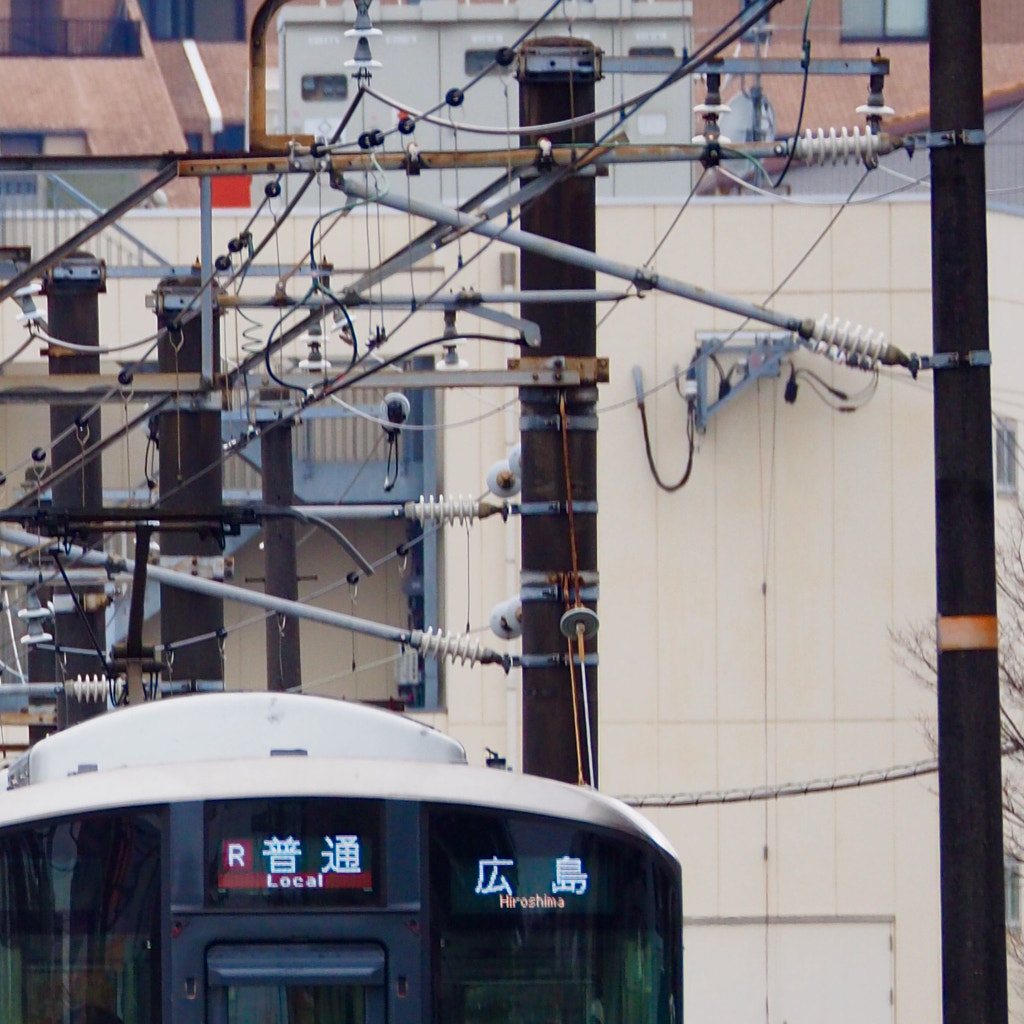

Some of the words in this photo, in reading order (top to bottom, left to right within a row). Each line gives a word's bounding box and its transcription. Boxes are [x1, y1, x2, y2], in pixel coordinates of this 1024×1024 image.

[228, 843, 245, 867] R
[262, 835, 361, 873] 普通
[267, 873, 323, 888] Local
[475, 855, 588, 895] 広島
[499, 893, 565, 909] Hiroshima
